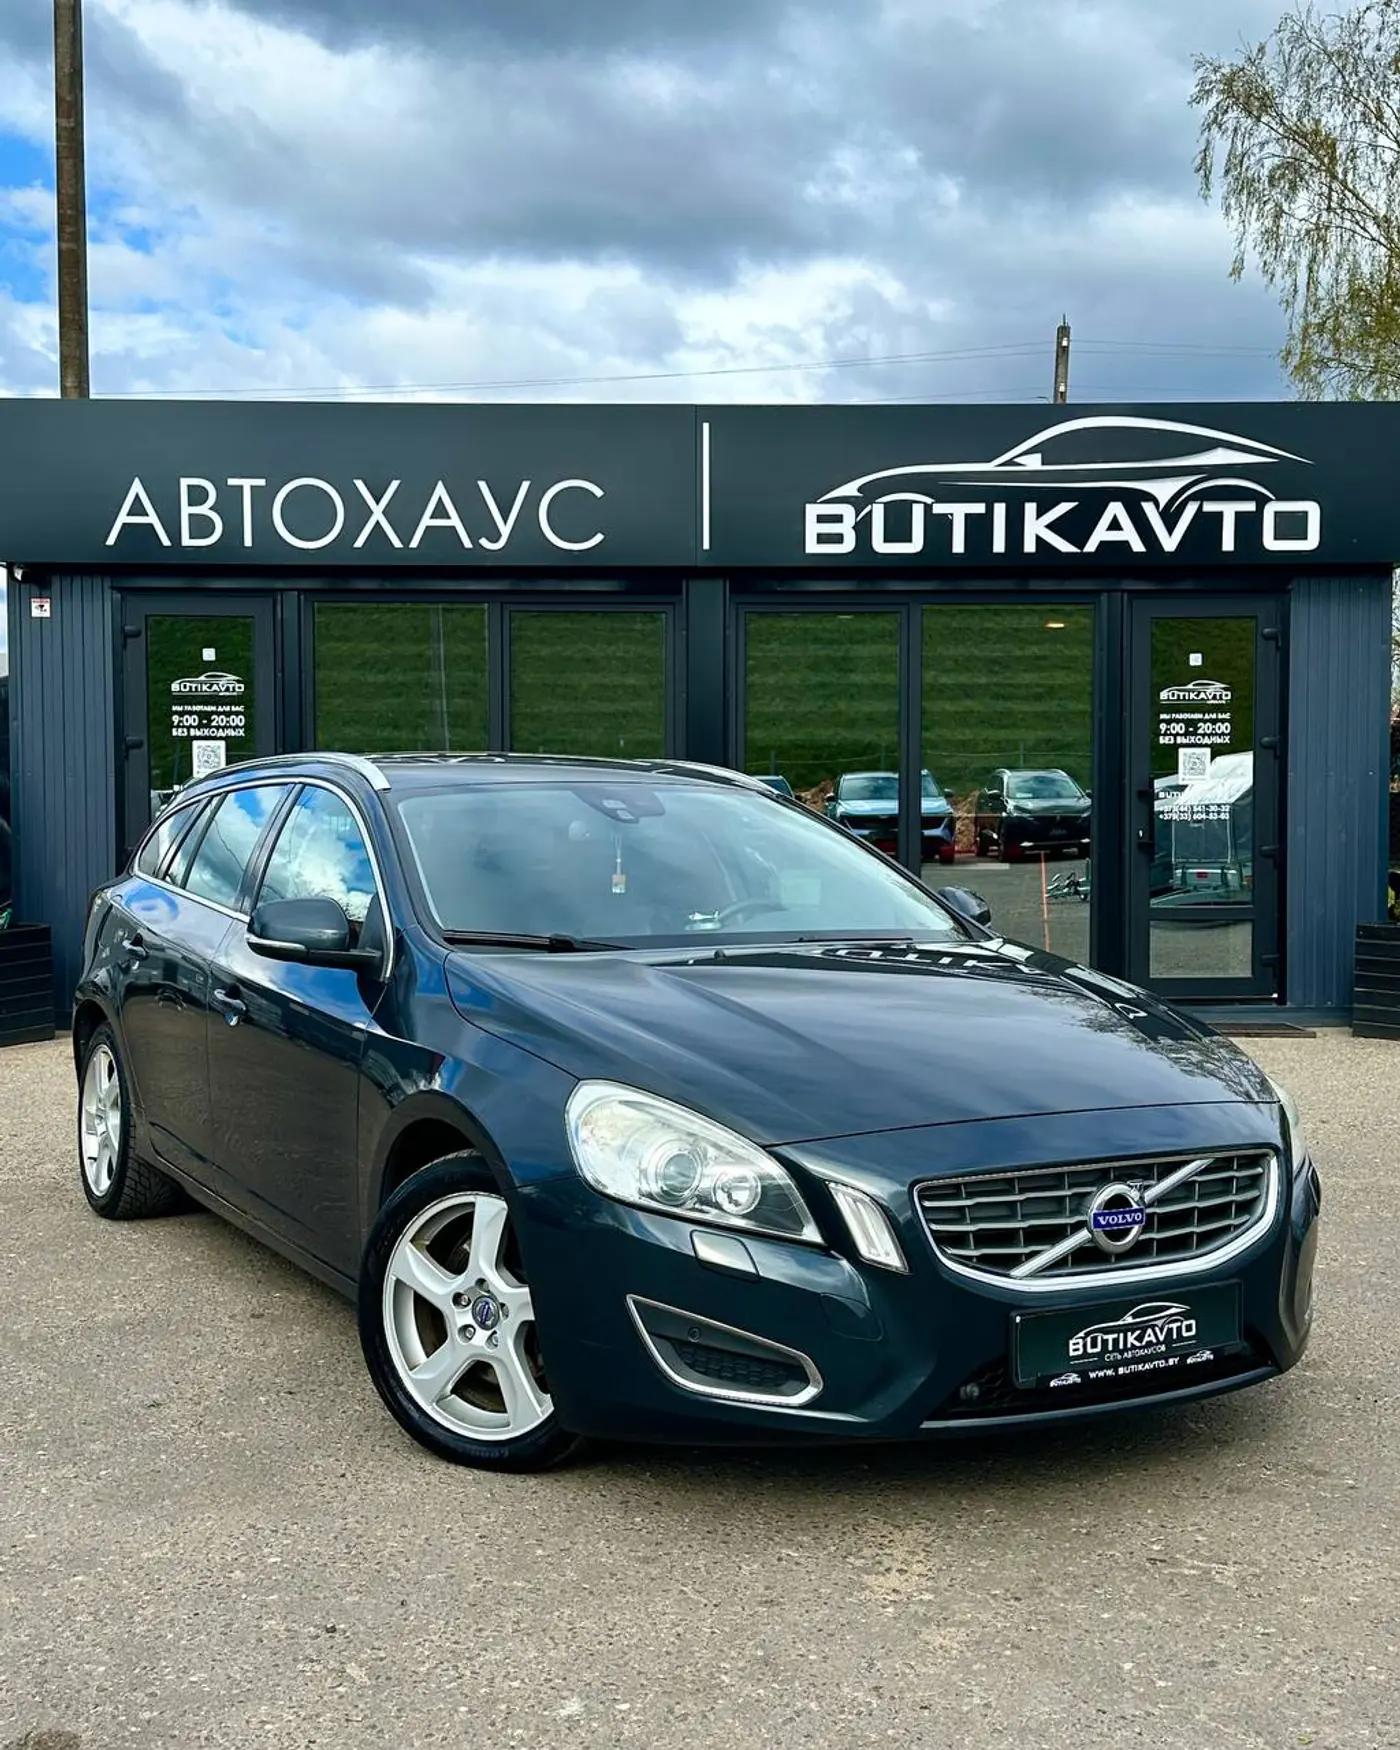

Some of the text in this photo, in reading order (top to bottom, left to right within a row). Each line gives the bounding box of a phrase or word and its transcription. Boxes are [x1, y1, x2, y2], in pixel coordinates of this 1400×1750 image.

[105, 477, 605, 551] АВТОХАУС
[805, 500, 1321, 554] BUTIKAVTO
[171, 683, 245, 692] BUTIKAVTO
[1160, 691, 1232, 700] BUTIKAVTO
[172, 715, 199, 726] 9:00
[211, 715, 245, 726] 20:00
[172, 728, 245, 737] БЕЗ ВЫХОДНЫХ
[1160, 722, 1186, 734] 9:00
[1197, 722, 1231, 734] 20:00
[1159, 735, 1231, 745] БЕЗ ВЫХОДНЫХ
[1097, 1212, 1142, 1225] VOLVO
[1069, 1319, 1197, 1357] BUTIKAVTO
[1088, 1366, 1116, 1380] WWW.
